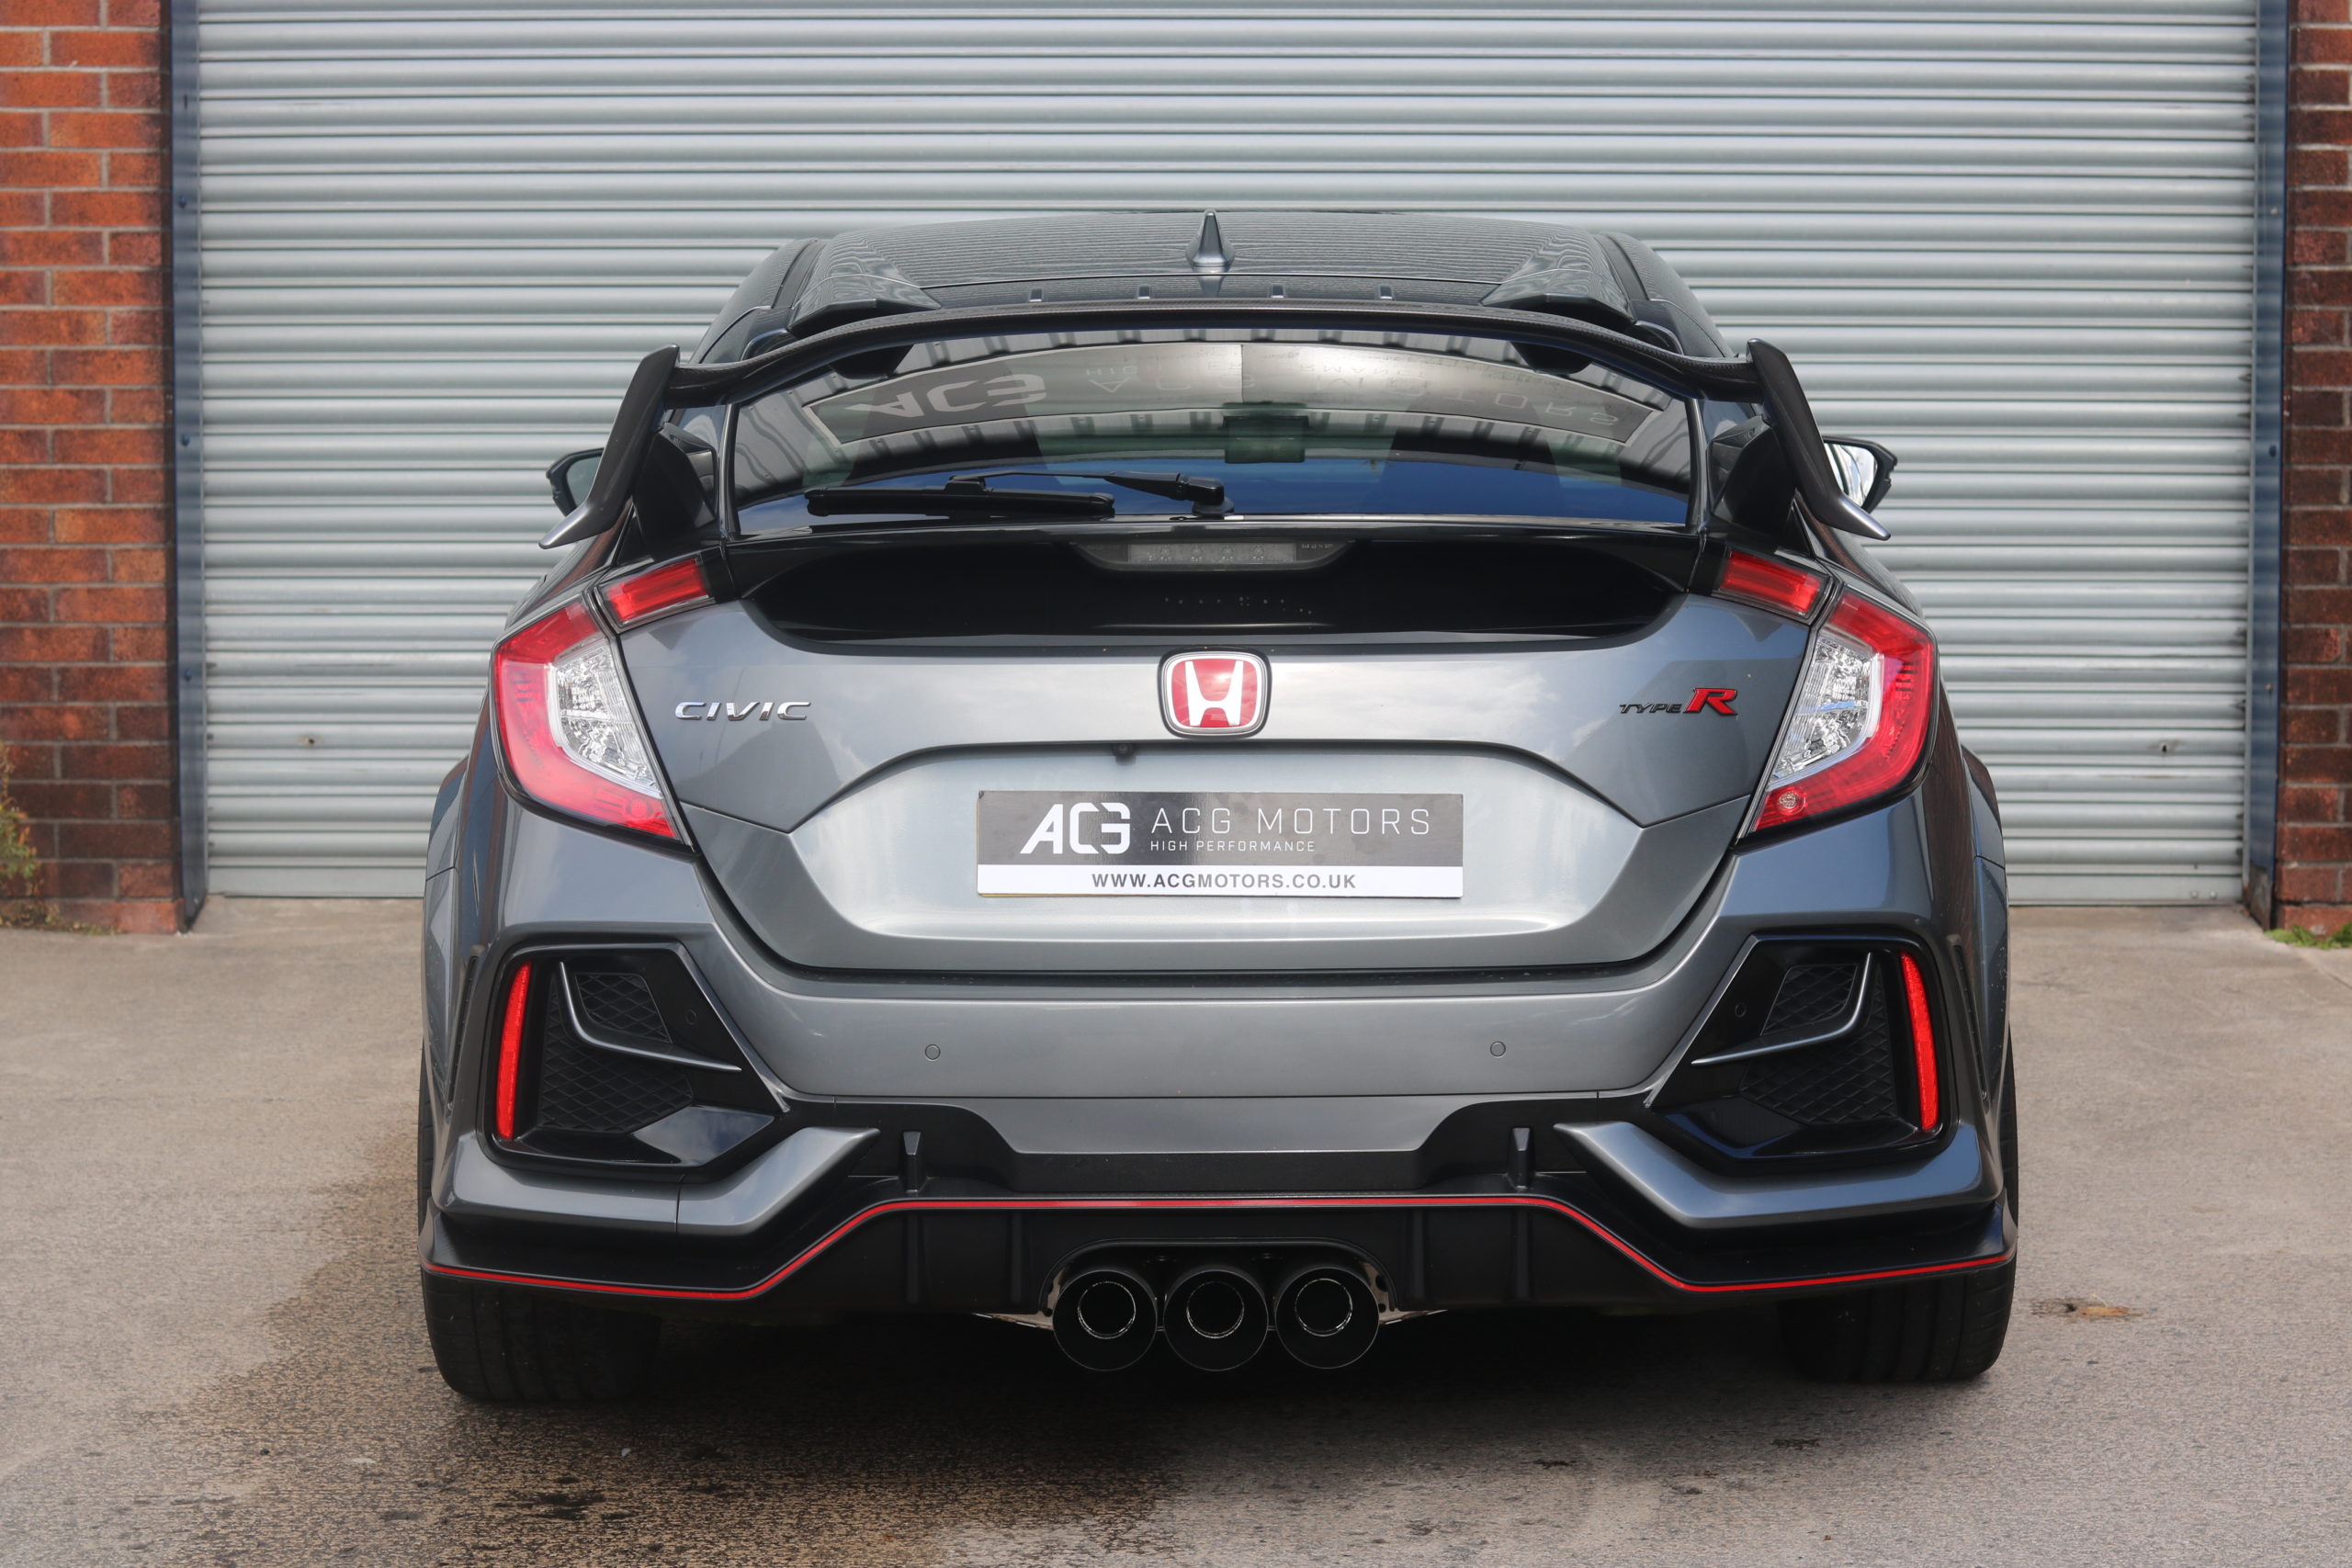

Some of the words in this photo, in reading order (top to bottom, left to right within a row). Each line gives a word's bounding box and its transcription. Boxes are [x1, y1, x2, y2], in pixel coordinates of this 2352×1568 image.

[675, 701, 811, 721] CIVIC
[1620, 703, 1683, 714] TYPE
[1684, 687, 1738, 716] R
[1019, 802, 1131, 855] ACG
[1151, 807, 1231, 835] ACG
[1257, 808, 1430, 836] MOTORS
[1150, 840, 1188, 852] HIGH
[1196, 840, 1316, 852] PERFORMANCE
[1091, 873, 1357, 889] WWW.ACGMOTORS.CO.UK
